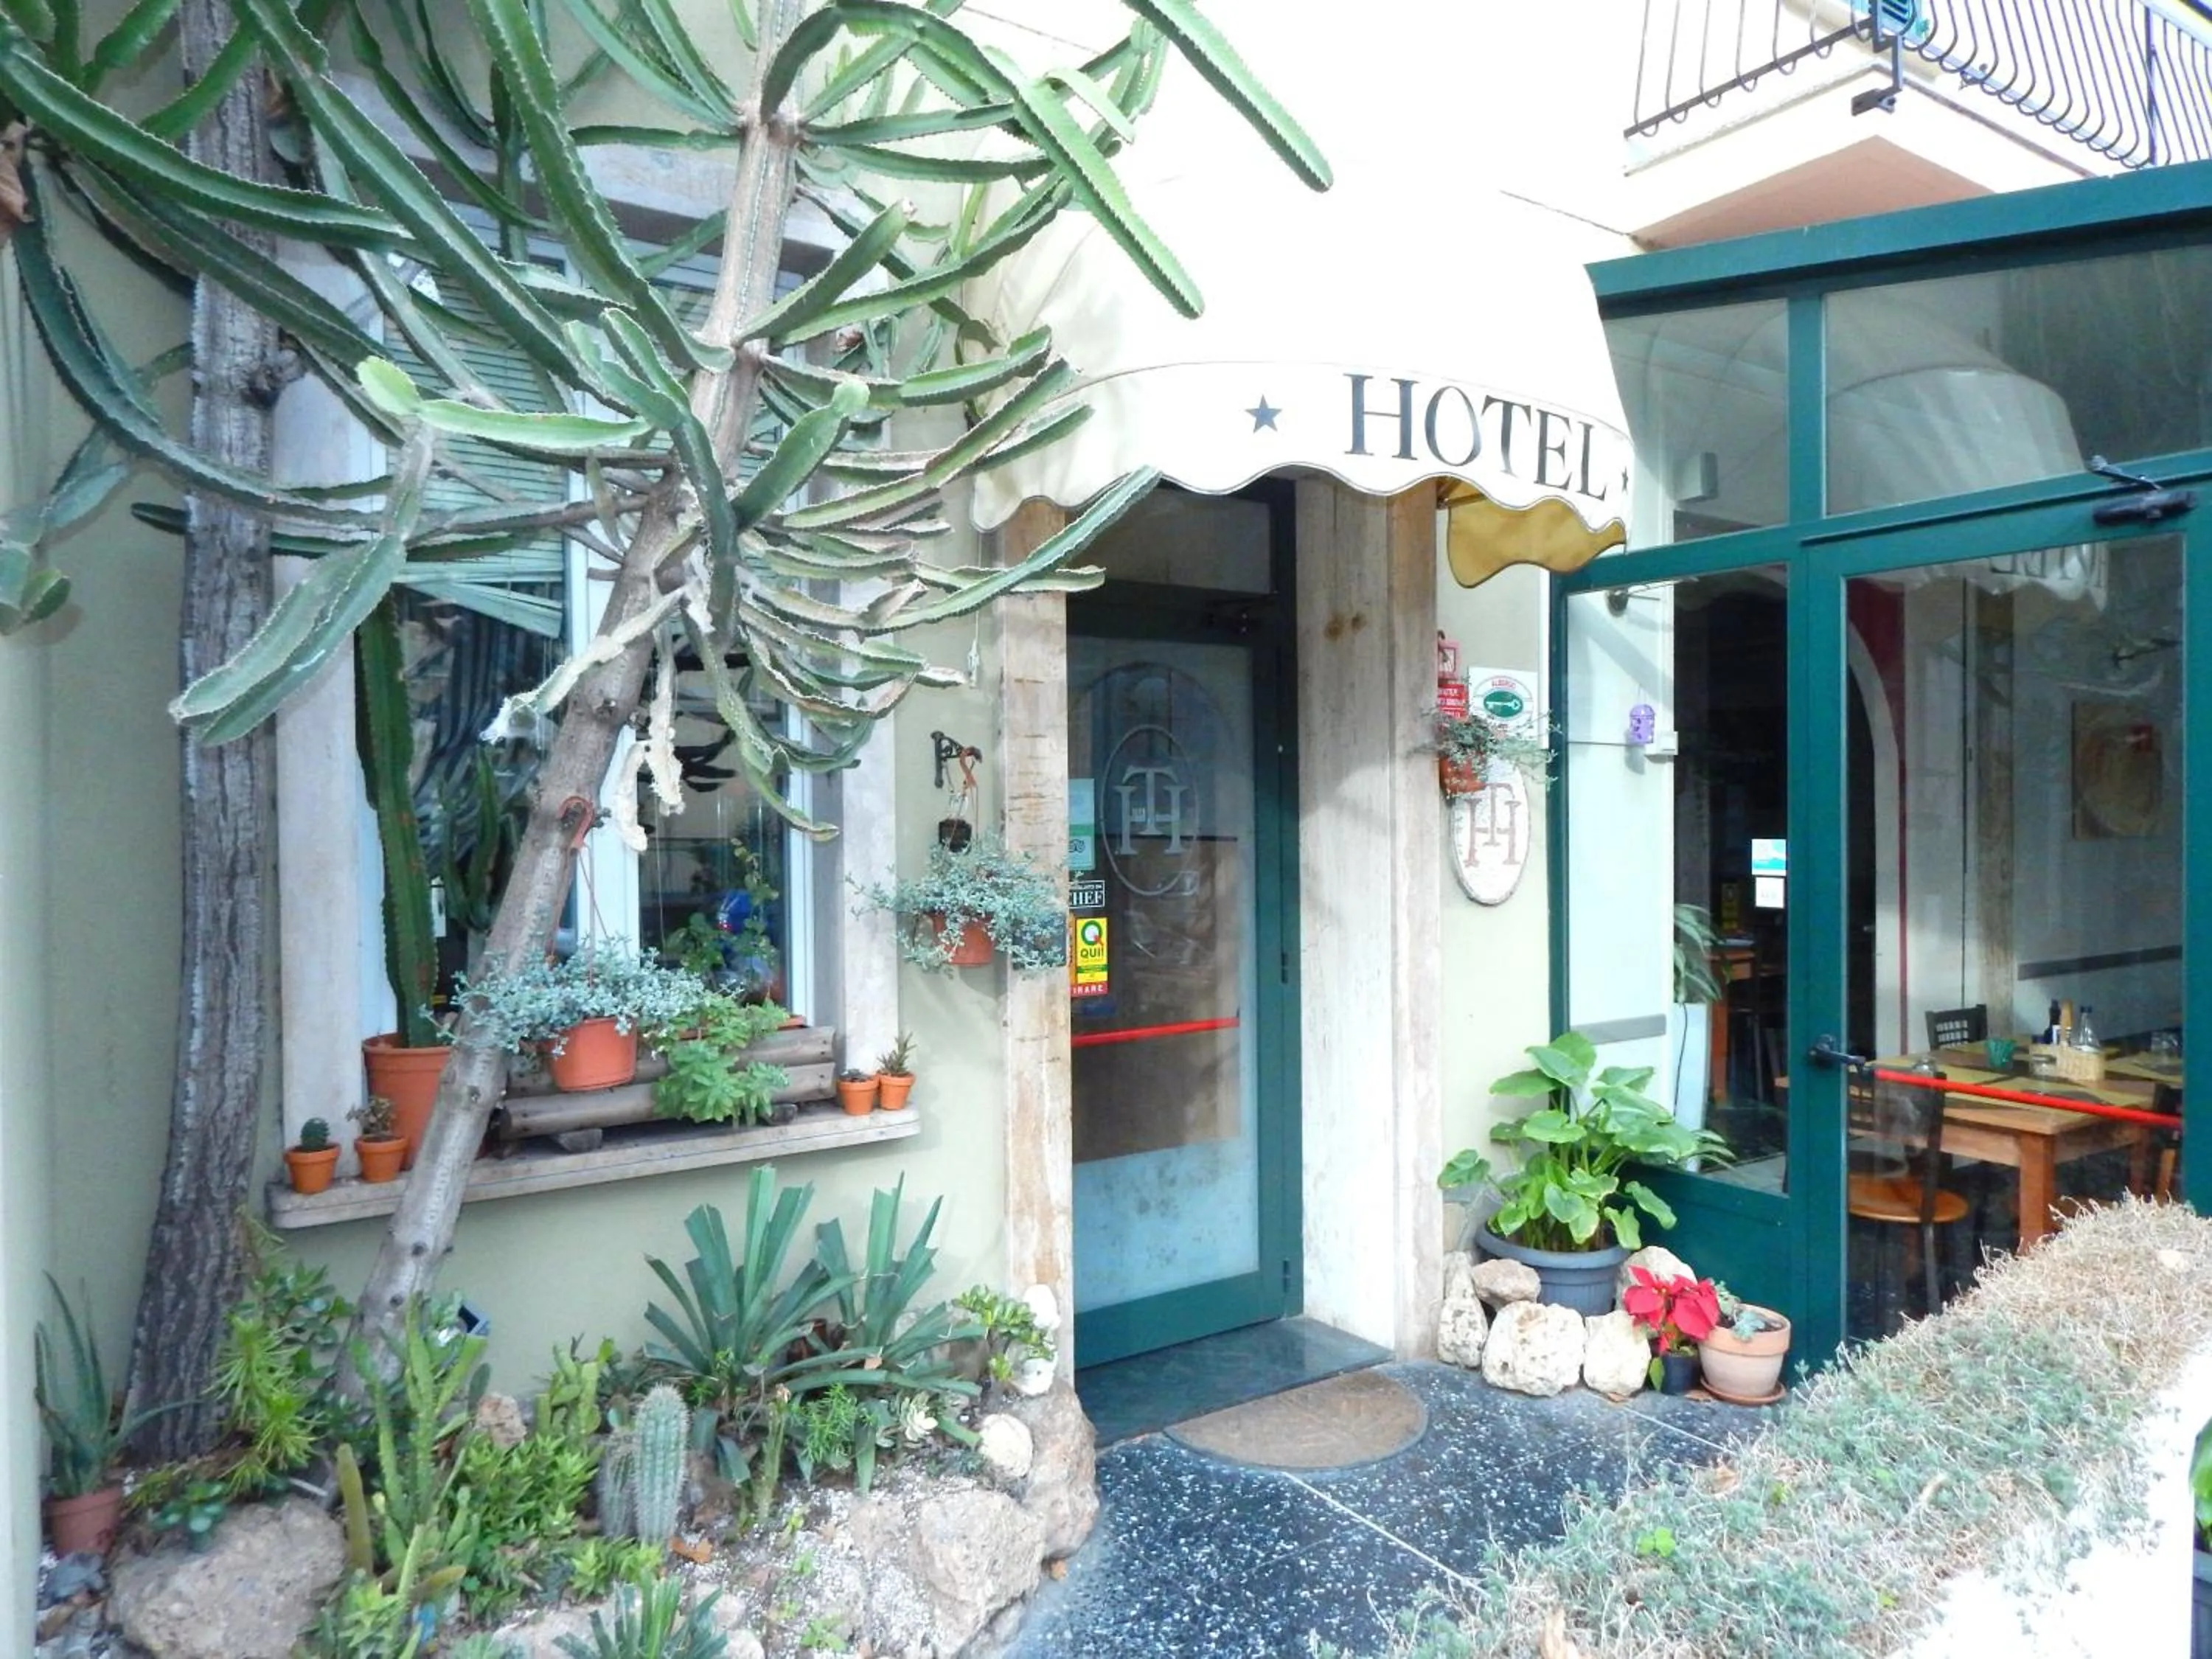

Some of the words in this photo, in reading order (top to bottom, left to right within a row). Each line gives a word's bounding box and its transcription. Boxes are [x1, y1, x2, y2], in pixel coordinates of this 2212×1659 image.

[1342, 372, 1607, 501] HOTEL
[1068, 891, 1104, 906] HEF
[1079, 947, 1105, 959] QUI!
[1071, 984, 1104, 995] IRARE
